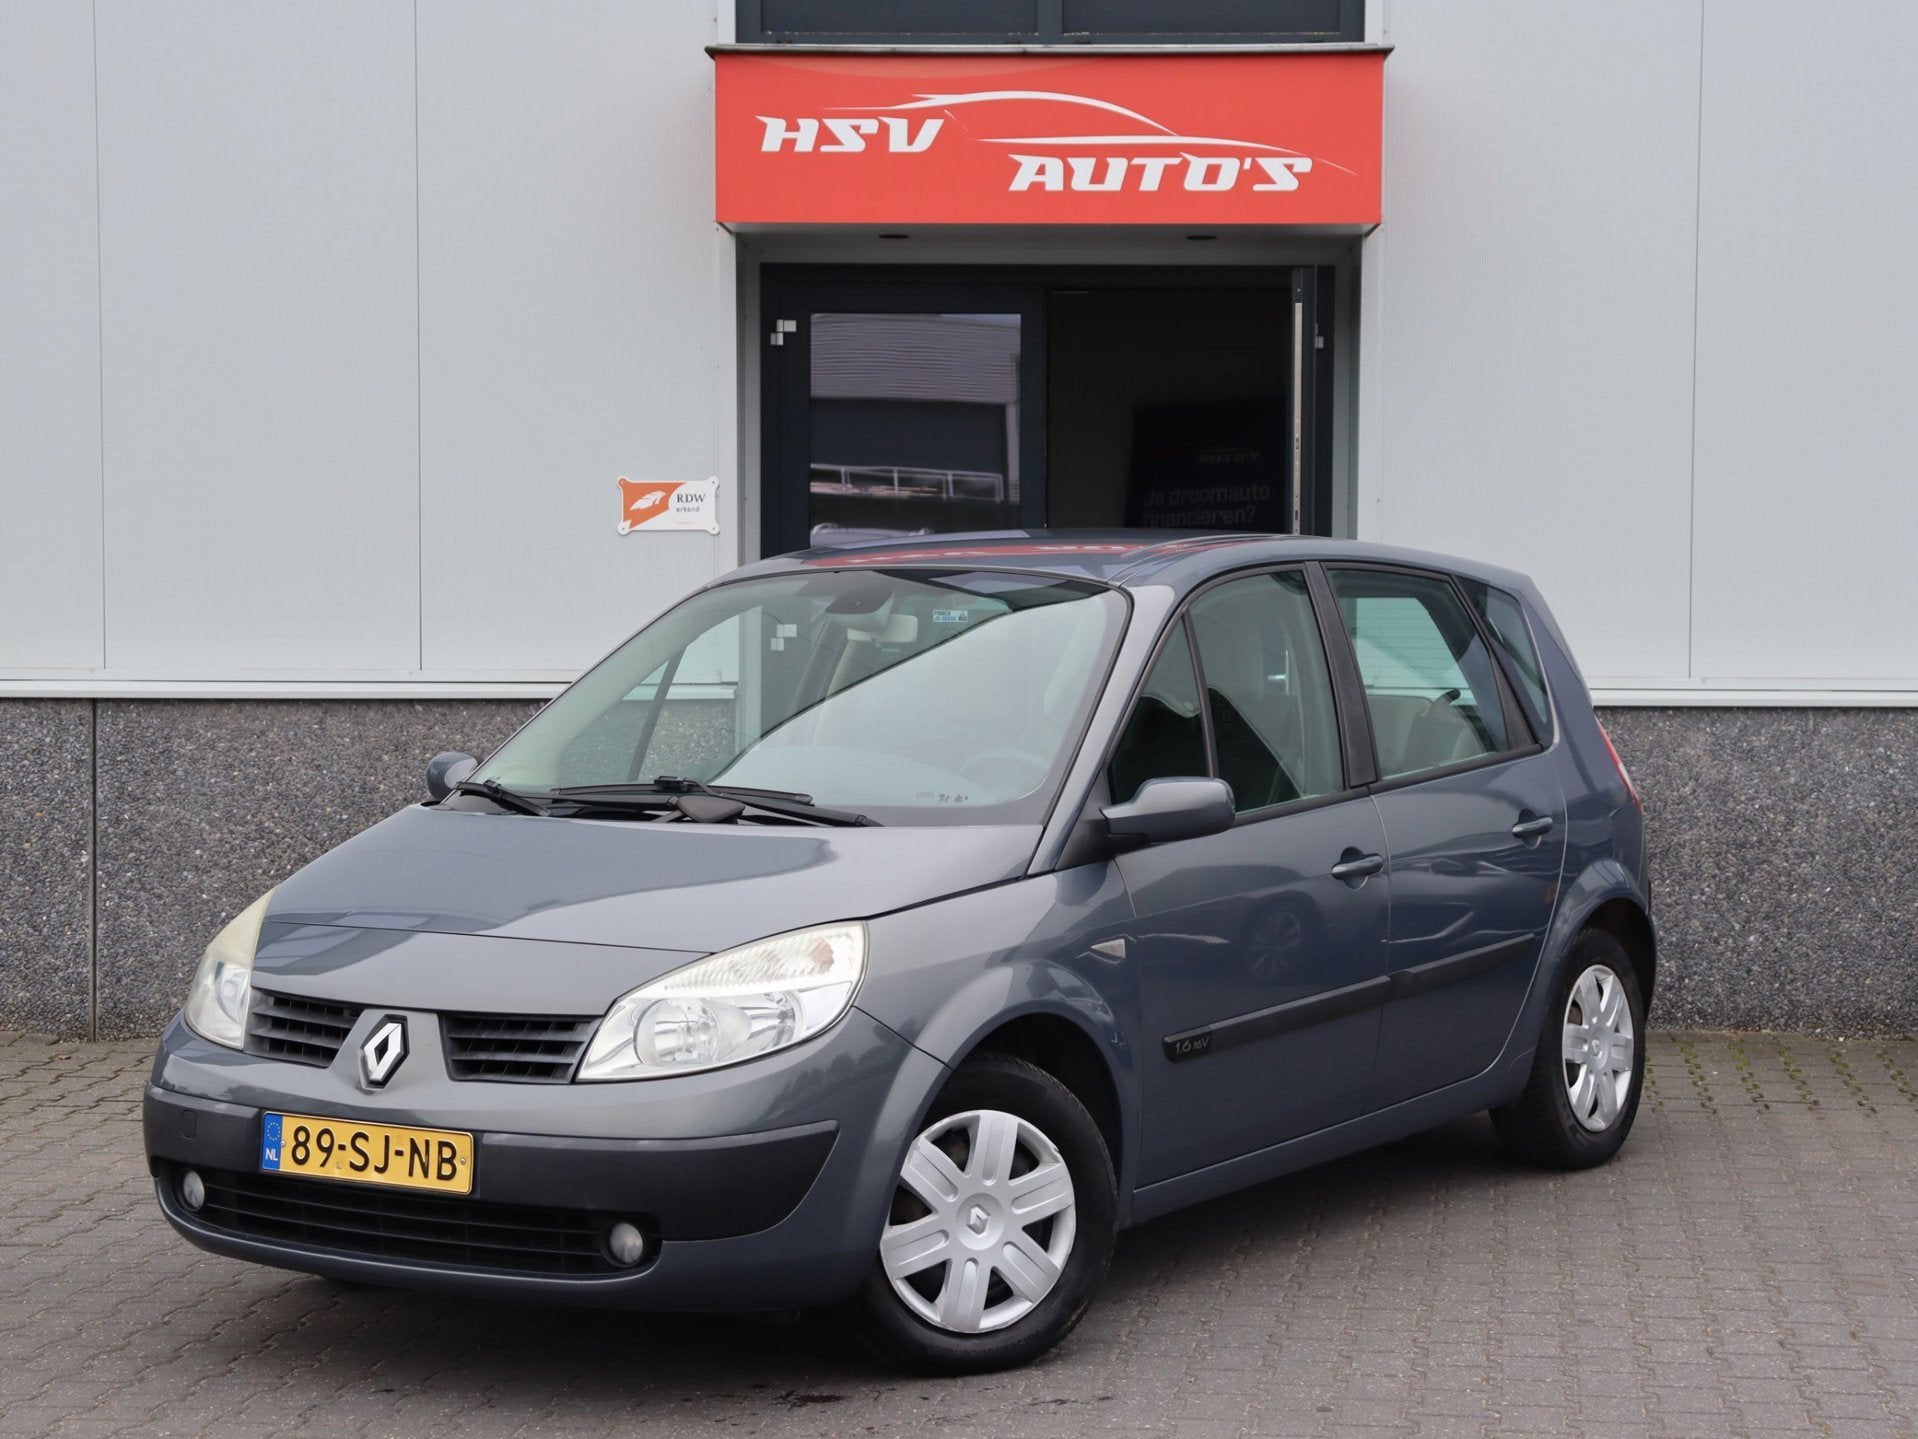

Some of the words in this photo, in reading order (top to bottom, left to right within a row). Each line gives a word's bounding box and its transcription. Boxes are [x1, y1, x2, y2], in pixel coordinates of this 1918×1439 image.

[756, 115, 945, 153] HSV
[1008, 152, 1312, 192] AUTO'S
[676, 493, 706, 503] RDW
[1169, 483, 1272, 506] droomauto
[1143, 506, 1256, 528] financieren?
[265, 1147, 279, 1162] NL
[291, 1125, 458, 1181] 89-SJ-NB
